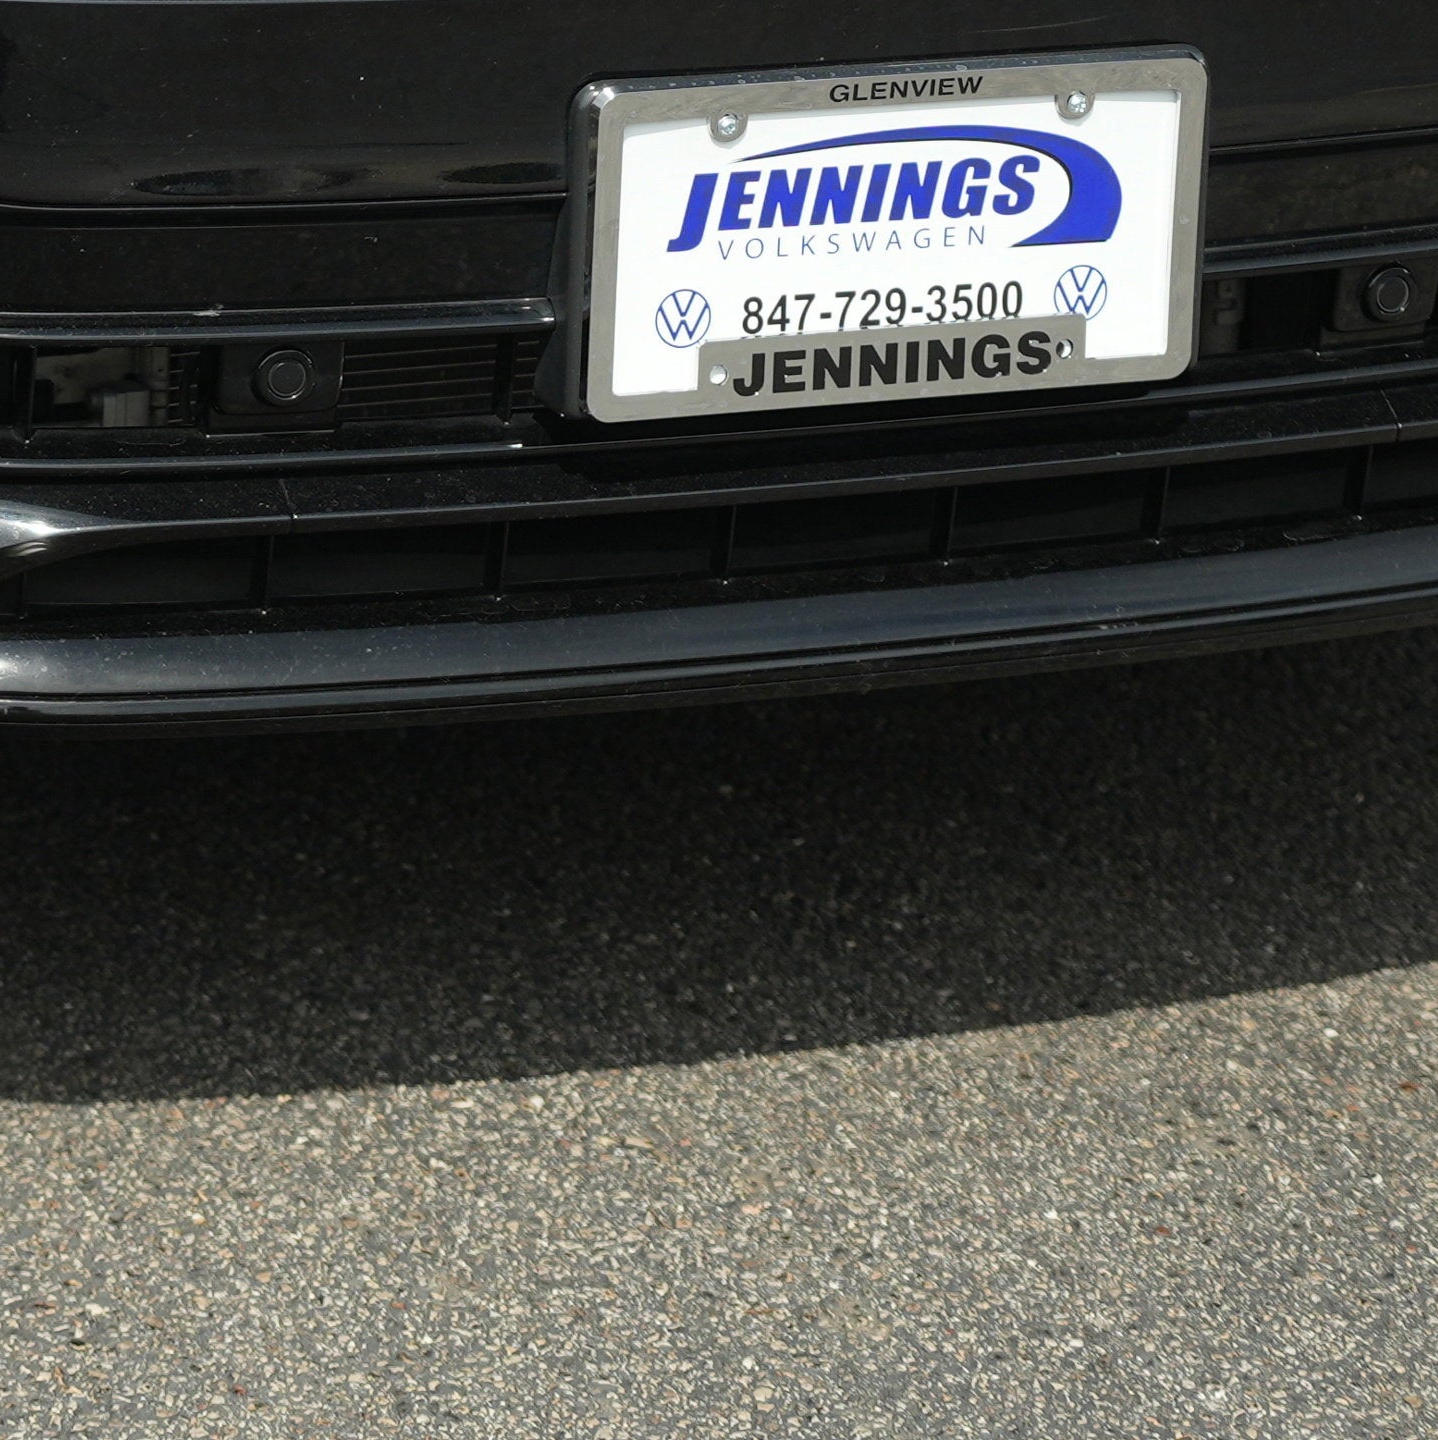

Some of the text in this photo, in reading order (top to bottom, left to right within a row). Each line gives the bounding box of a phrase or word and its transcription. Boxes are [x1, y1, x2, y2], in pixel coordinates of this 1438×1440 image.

[828, 75, 984, 103] GLENVIEW
[666, 155, 1040, 252] JENNINGS
[717, 224, 986, 261] VOLKSWAGEN
[742, 280, 1024, 335] 847-729-3500
[732, 330, 1052, 397] JENNINGS
